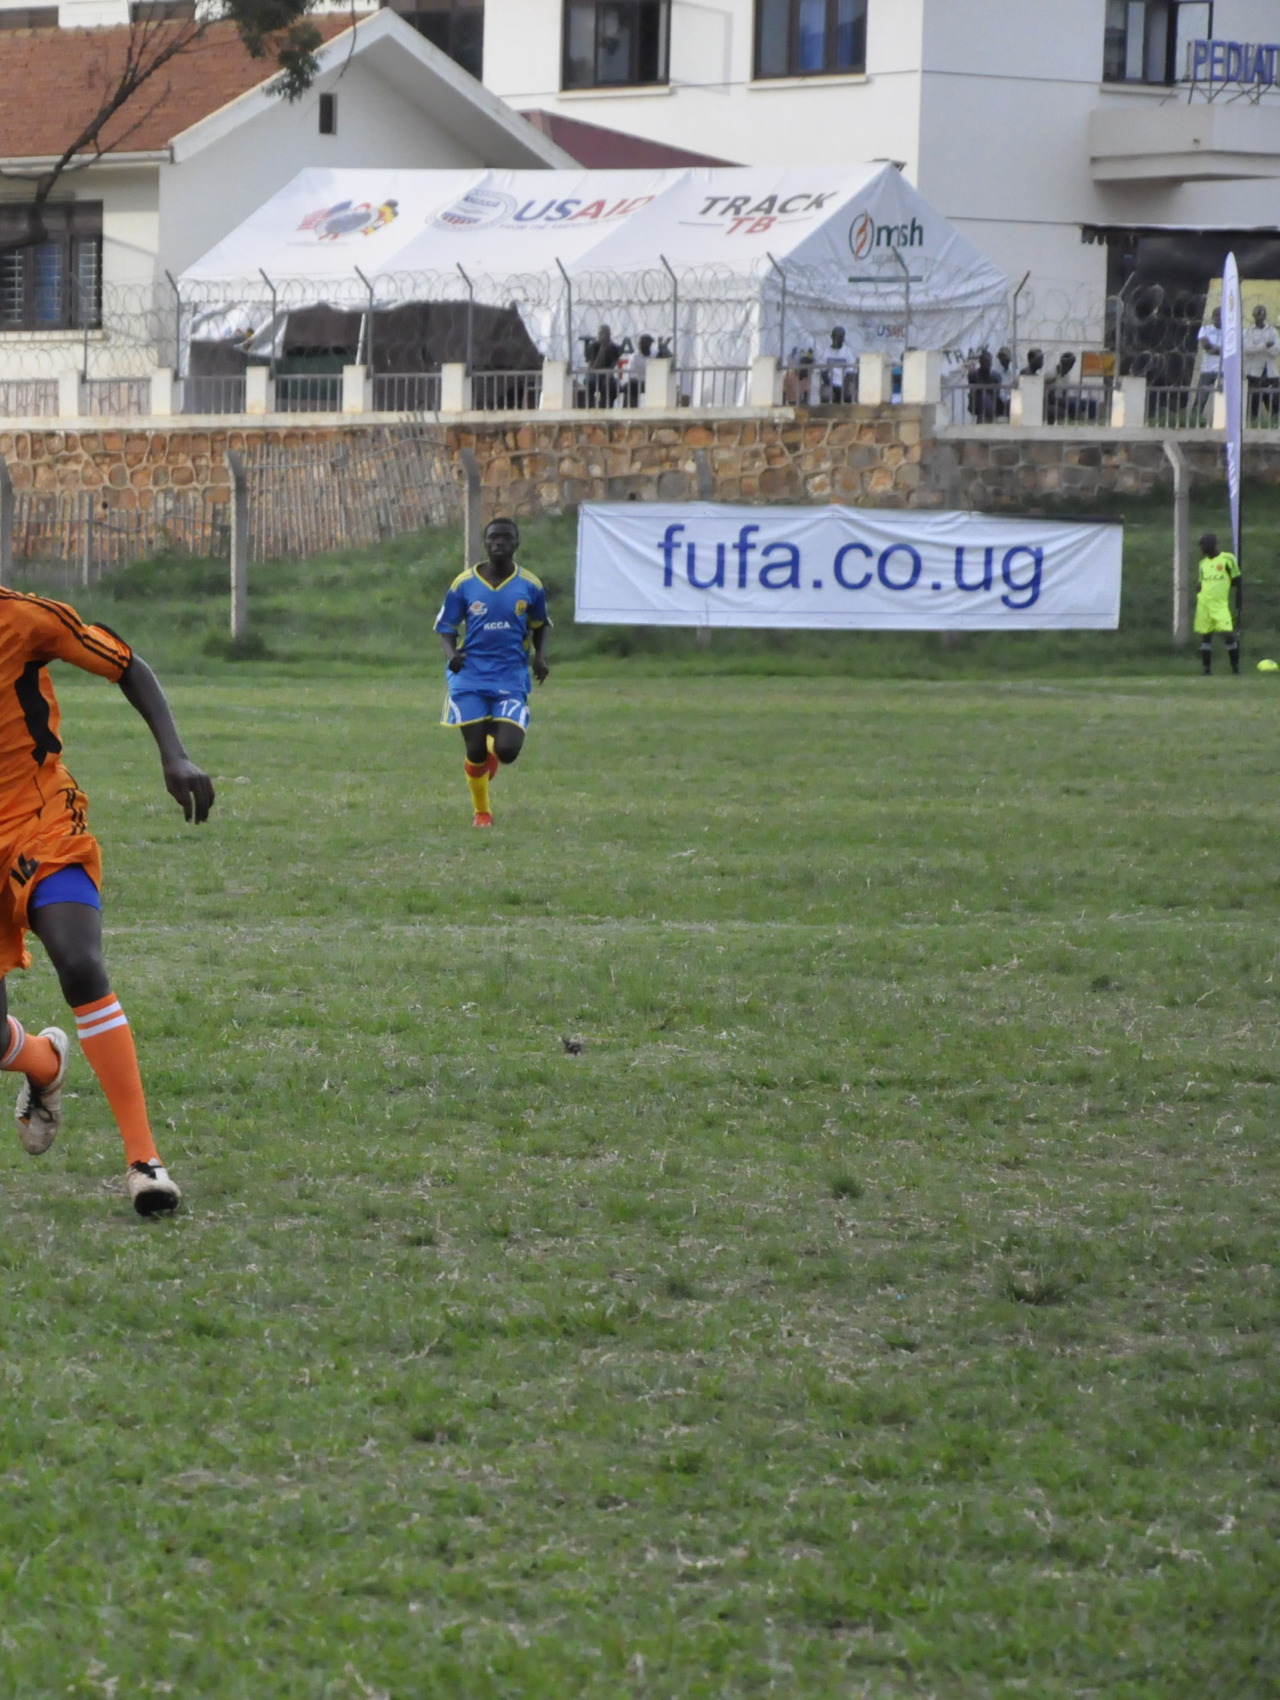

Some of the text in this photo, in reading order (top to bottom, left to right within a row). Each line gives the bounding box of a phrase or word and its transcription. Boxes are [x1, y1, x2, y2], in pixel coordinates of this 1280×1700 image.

[513, 195, 656, 221] USAID
[699, 191, 839, 216] TRACK
[726, 216, 777, 235] TB
[876, 216, 923, 247] msh
[578, 336, 673, 362] TAK
[657, 524, 1043, 609] fufa.co.ug
[483, 621, 511, 630] KCCA
[500, 699, 521, 717] 17
